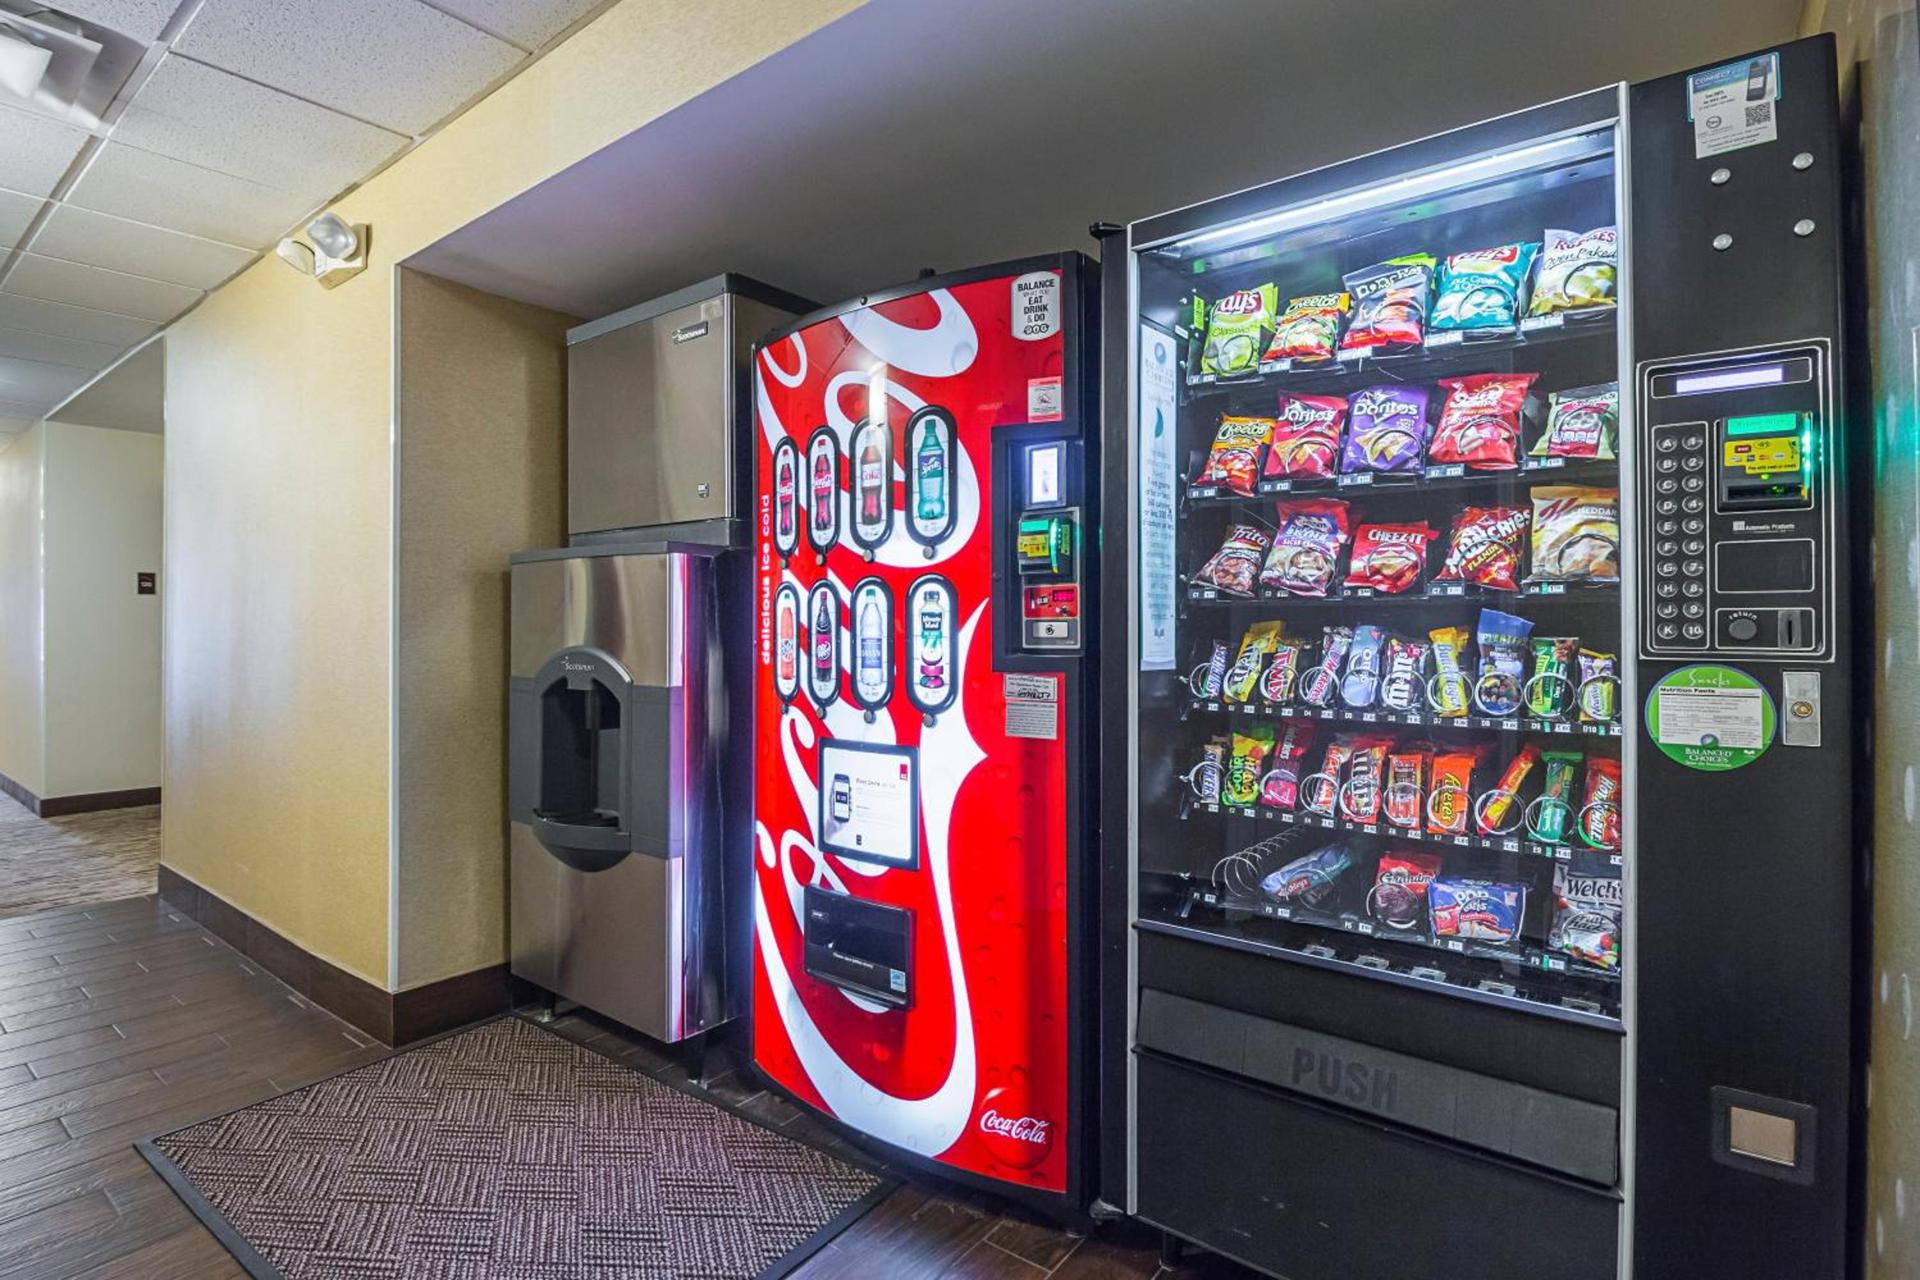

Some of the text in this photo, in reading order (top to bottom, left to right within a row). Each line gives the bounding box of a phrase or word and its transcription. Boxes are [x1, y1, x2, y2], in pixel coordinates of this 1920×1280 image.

[1018, 279, 1055, 291] BALANCE
[1029, 296, 1043, 304] EAT
[1024, 304, 1048, 314] DRINK
[1034, 313, 1045, 321] DO
[1353, 403, 1418, 416] Doritos
[1662, 438, 1672, 447] A
[1663, 458, 1697, 468] B 2
[1663, 479, 1698, 489] C 3
[1663, 501, 1672, 509] D
[1664, 521, 1697, 530] E 5
[1368, 529, 1425, 544] CHEEZ-IT
[1663, 563, 1698, 572] G 7
[761, 495, 771, 665] delicious ice cold
[1690, 605, 1698, 613] 9
[1728, 611, 1758, 620] return
[1664, 626, 1702, 634] K 10
[1685, 748, 1732, 757] BALANCED
[1689, 755, 1728, 763] CHOICES
[1443, 773, 1462, 821] Reese's
[1292, 1047, 1399, 1113] PUSH
[980, 1110, 1050, 1144] Coca-Cola
